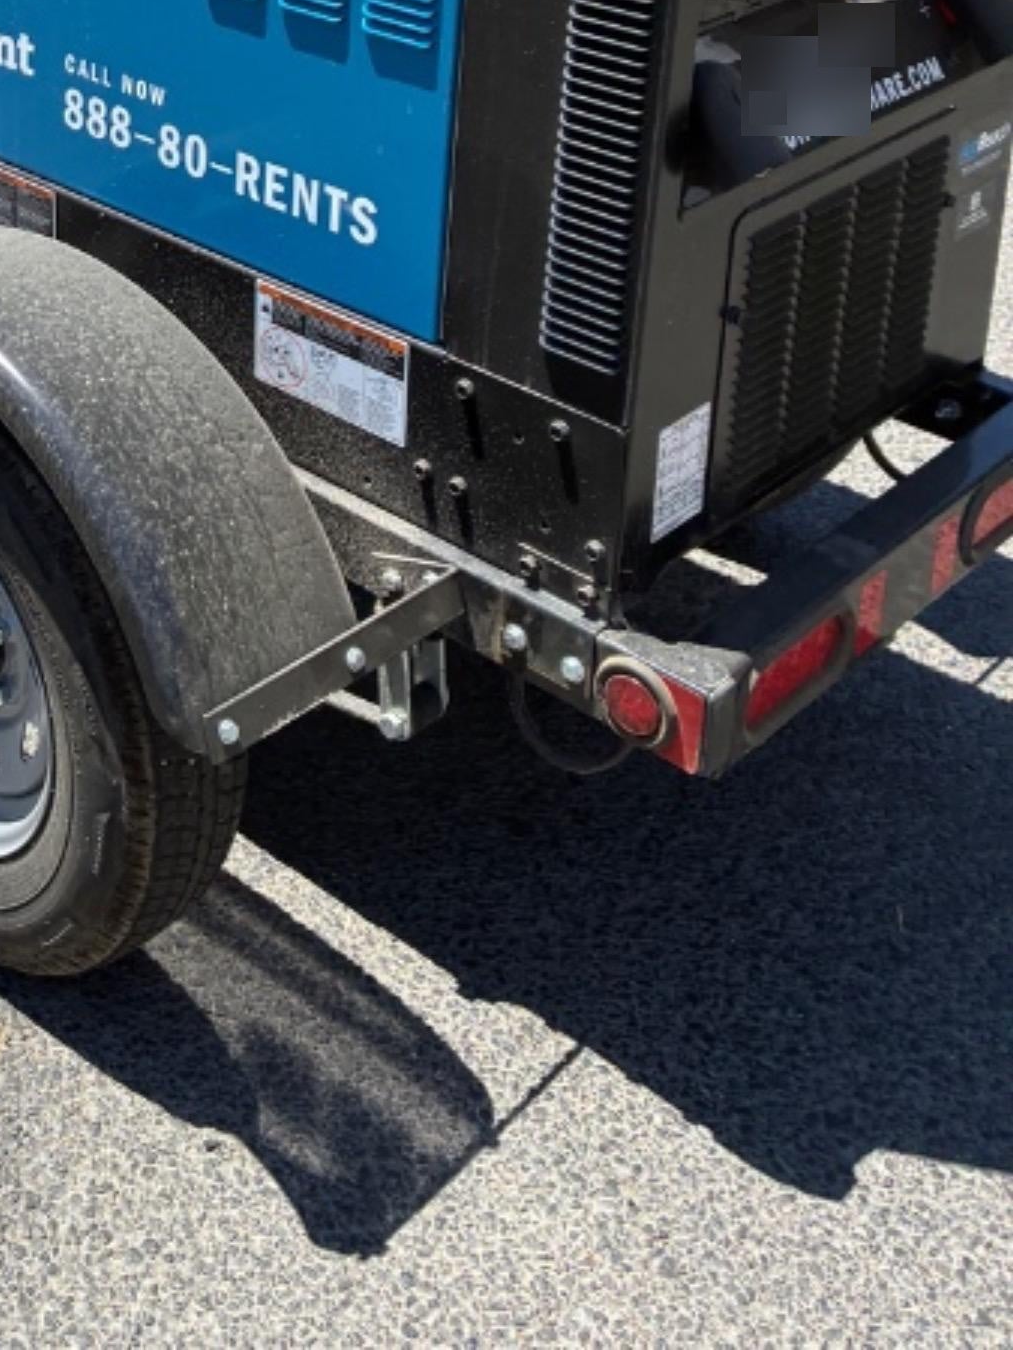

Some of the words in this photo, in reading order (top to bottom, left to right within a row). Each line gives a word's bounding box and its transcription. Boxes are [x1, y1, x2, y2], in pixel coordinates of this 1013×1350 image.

[64, 53, 112, 88] CALL
[121, 74, 166, 107] NOW
[63, 88, 379, 246] 888-80-RENTS
